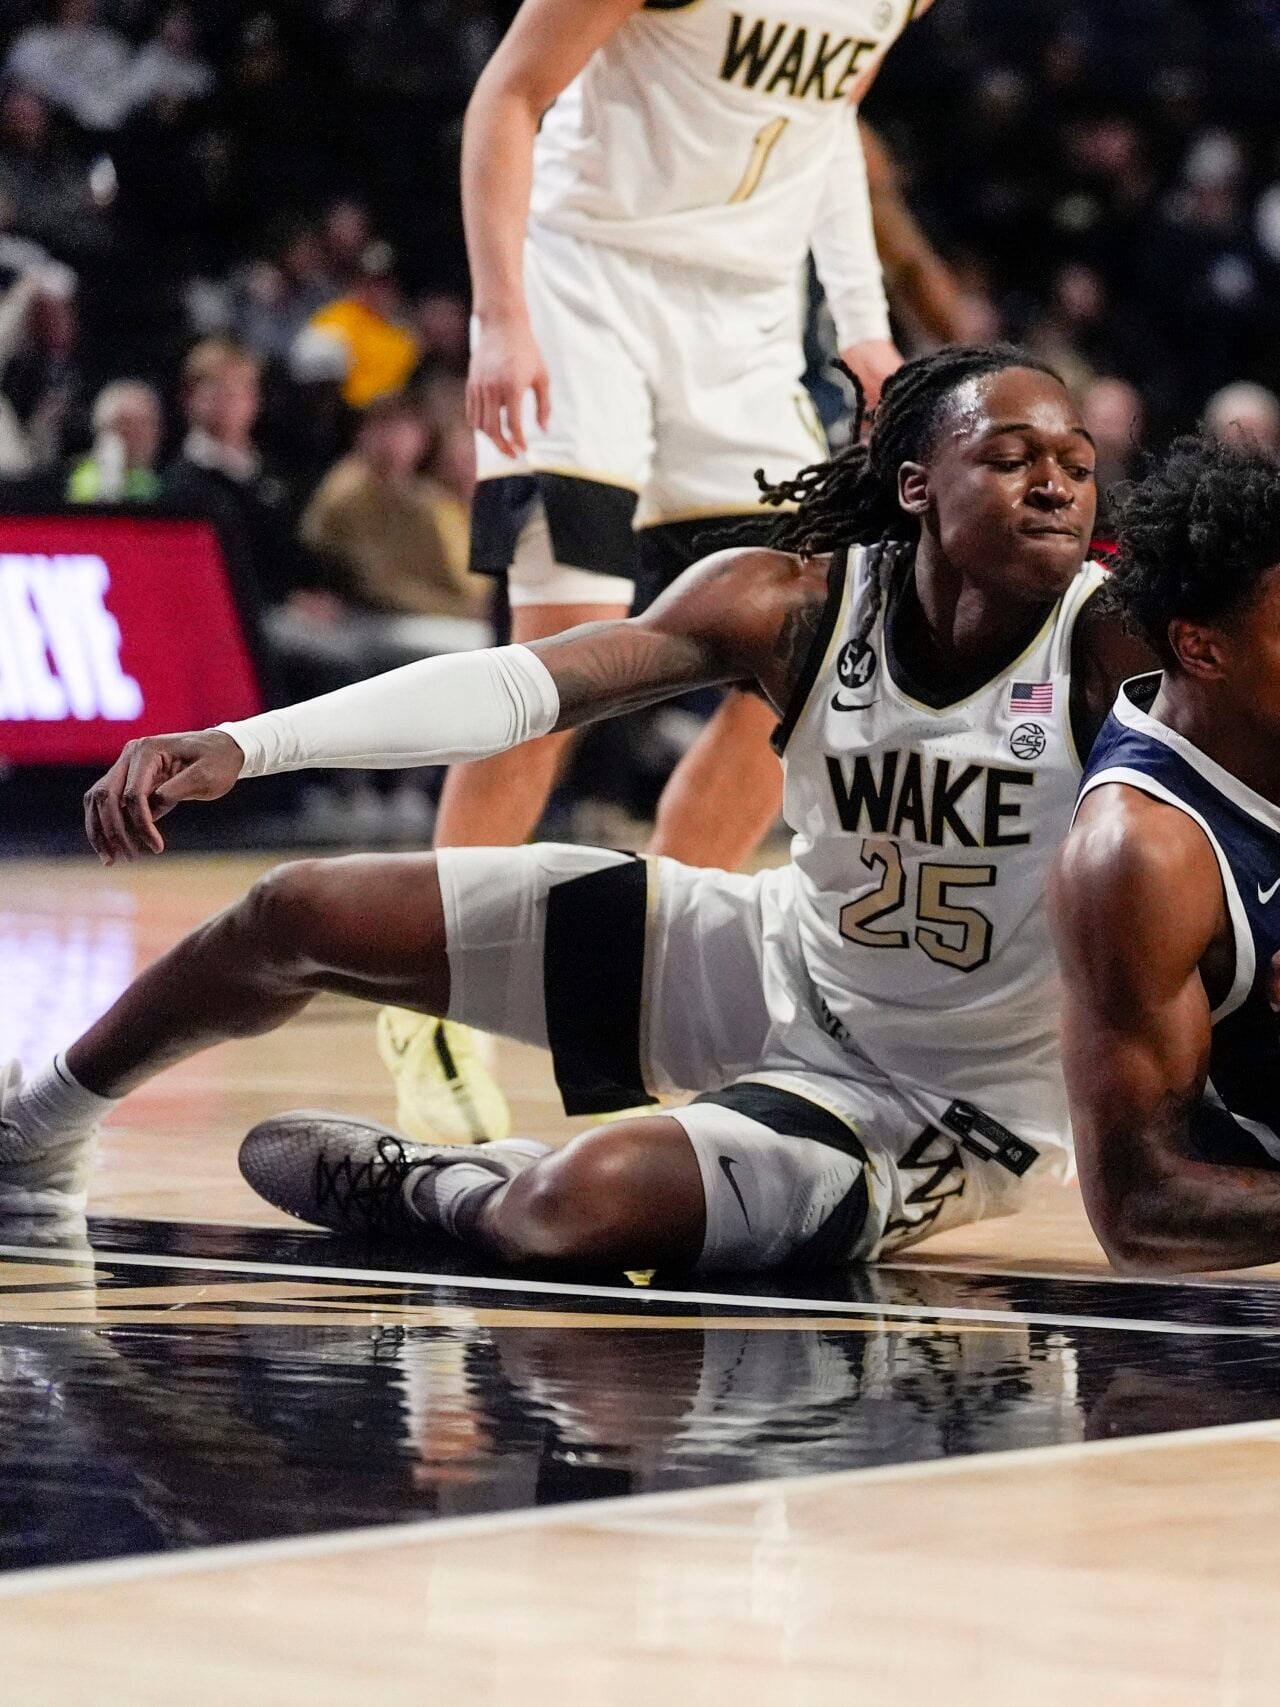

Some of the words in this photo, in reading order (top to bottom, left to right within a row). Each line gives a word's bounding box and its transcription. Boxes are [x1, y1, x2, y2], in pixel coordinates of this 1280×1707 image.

[720, 13, 877, 102] WAKE
[840, 643, 873, 683] 54
[825, 750, 1034, 848] WAKE
[839, 838, 997, 972] 25
